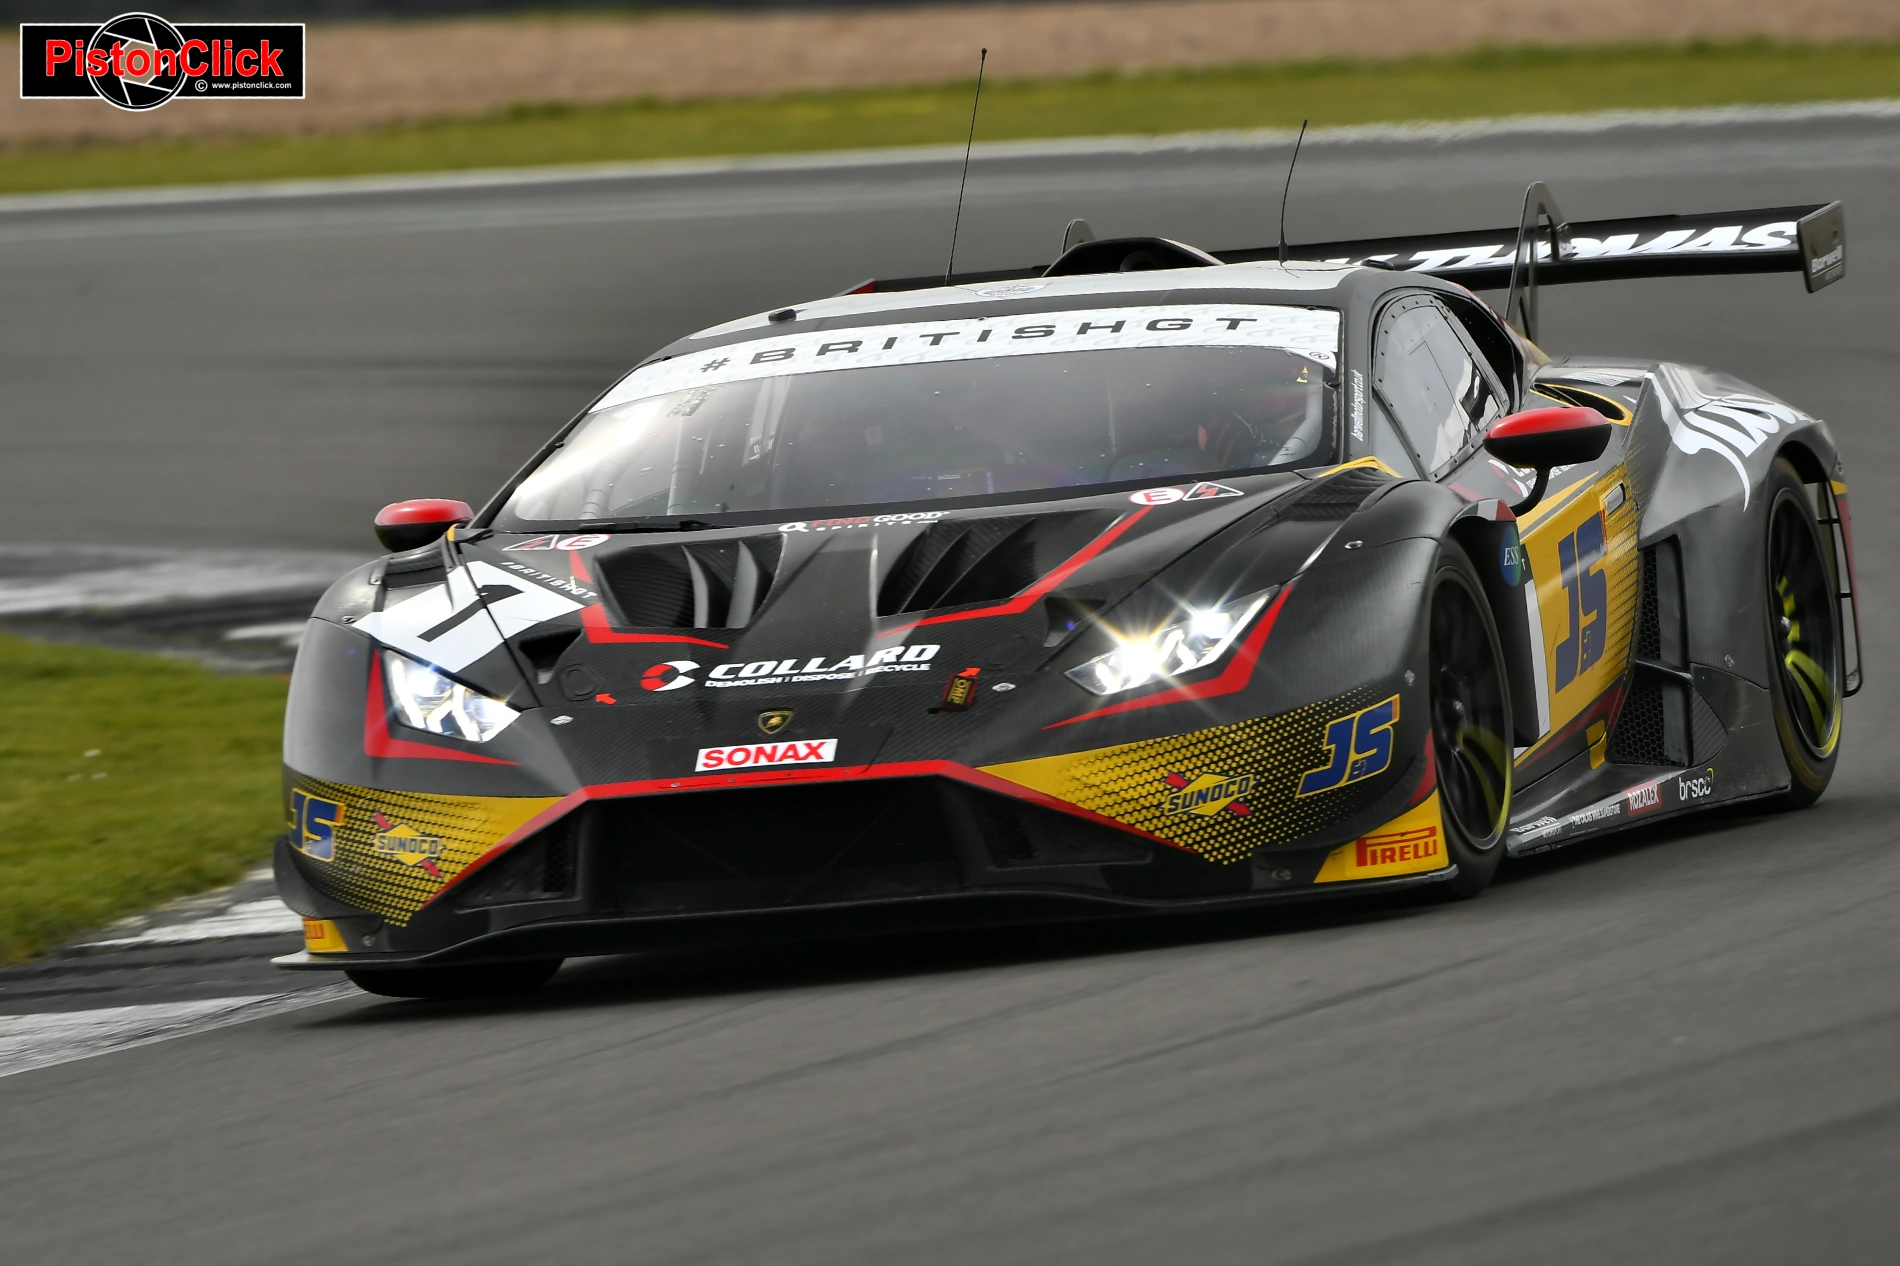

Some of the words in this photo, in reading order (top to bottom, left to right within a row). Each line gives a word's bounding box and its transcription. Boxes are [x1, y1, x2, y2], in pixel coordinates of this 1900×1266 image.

[1504, 546, 1519, 566] ESS
[704, 675, 783, 688] DEMOLISH
[792, 672, 855, 683] DISPOSE
[865, 663, 931, 676] RECYCLE
[708, 645, 941, 680] COLLARD
[702, 741, 828, 769] SONAX
[1295, 694, 1400, 799] JS
[1166, 777, 1252, 815] SUNOCO
[1628, 784, 1659, 811] ROZALEX
[377, 834, 442, 856] SUNOCO
[1356, 826, 1437, 867] PIRELLI
